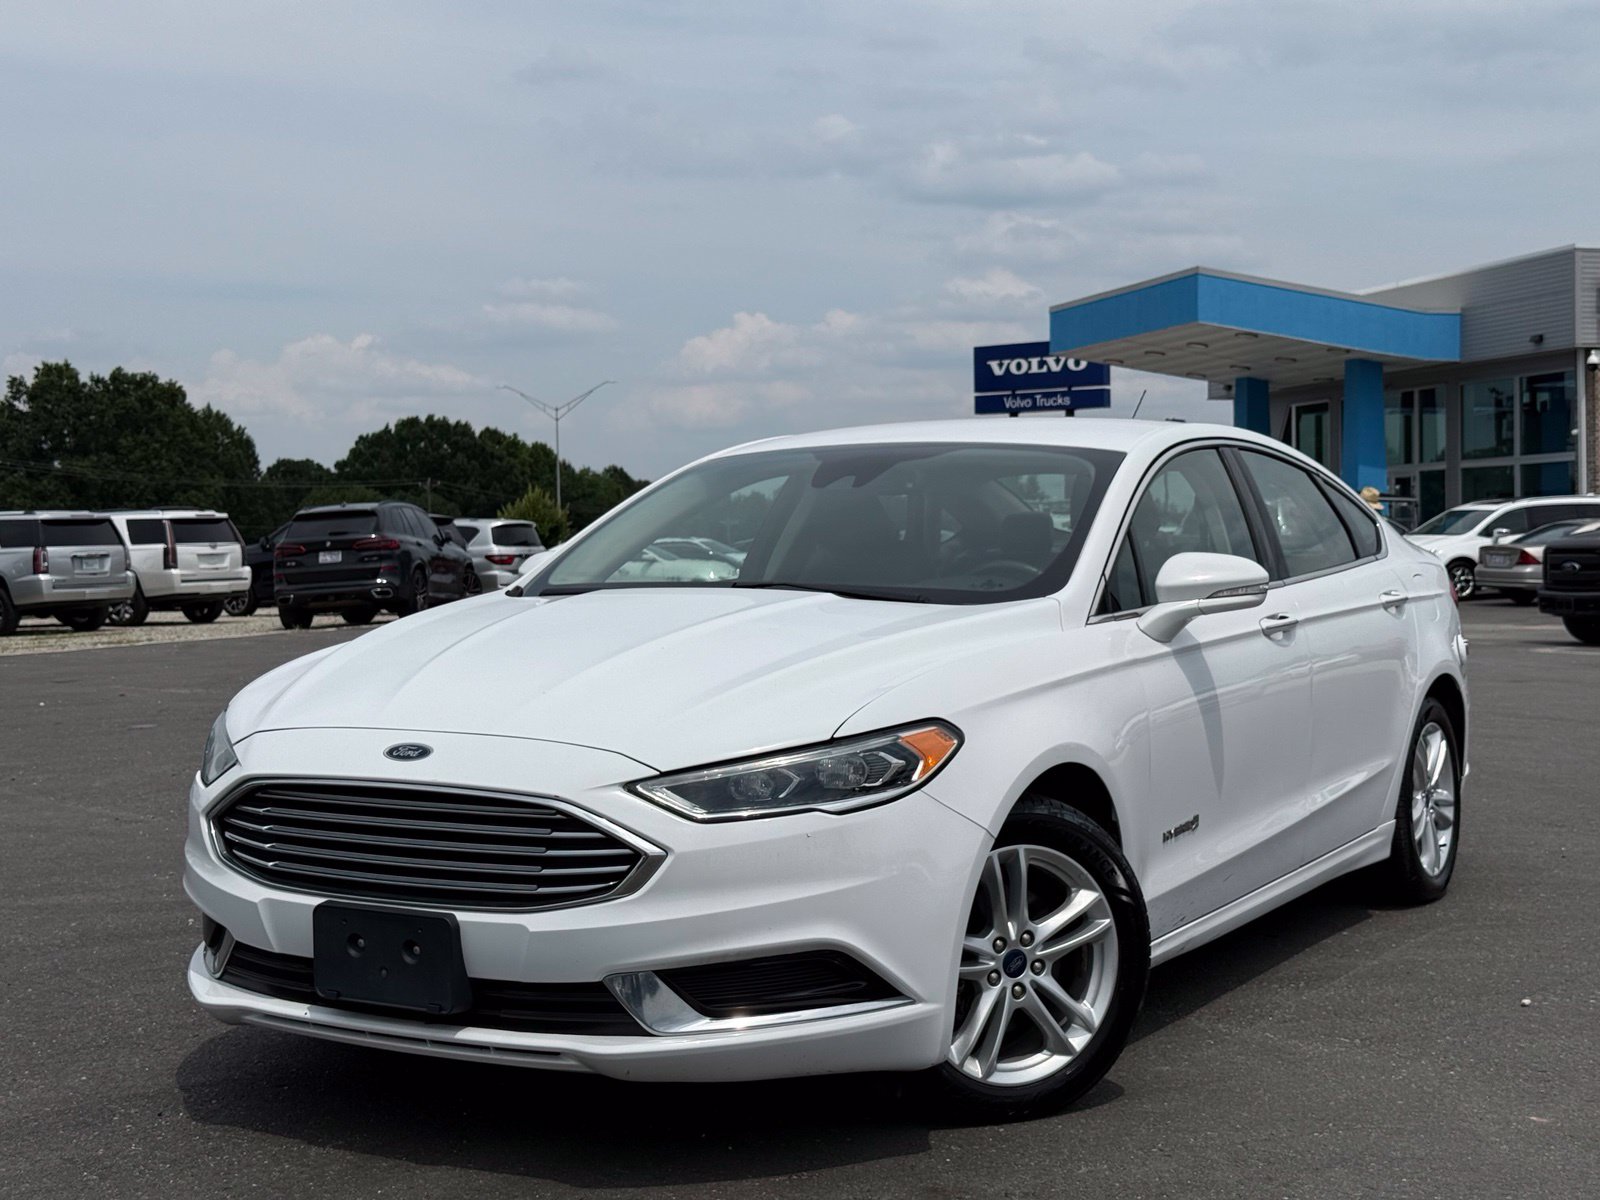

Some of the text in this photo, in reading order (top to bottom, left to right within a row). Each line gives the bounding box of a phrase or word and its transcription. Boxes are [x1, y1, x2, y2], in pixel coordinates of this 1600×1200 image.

[986, 356, 1088, 376] VOLVO
[1003, 393, 1071, 409] Volvo Trucks
[392, 746, 423, 757] Ford
